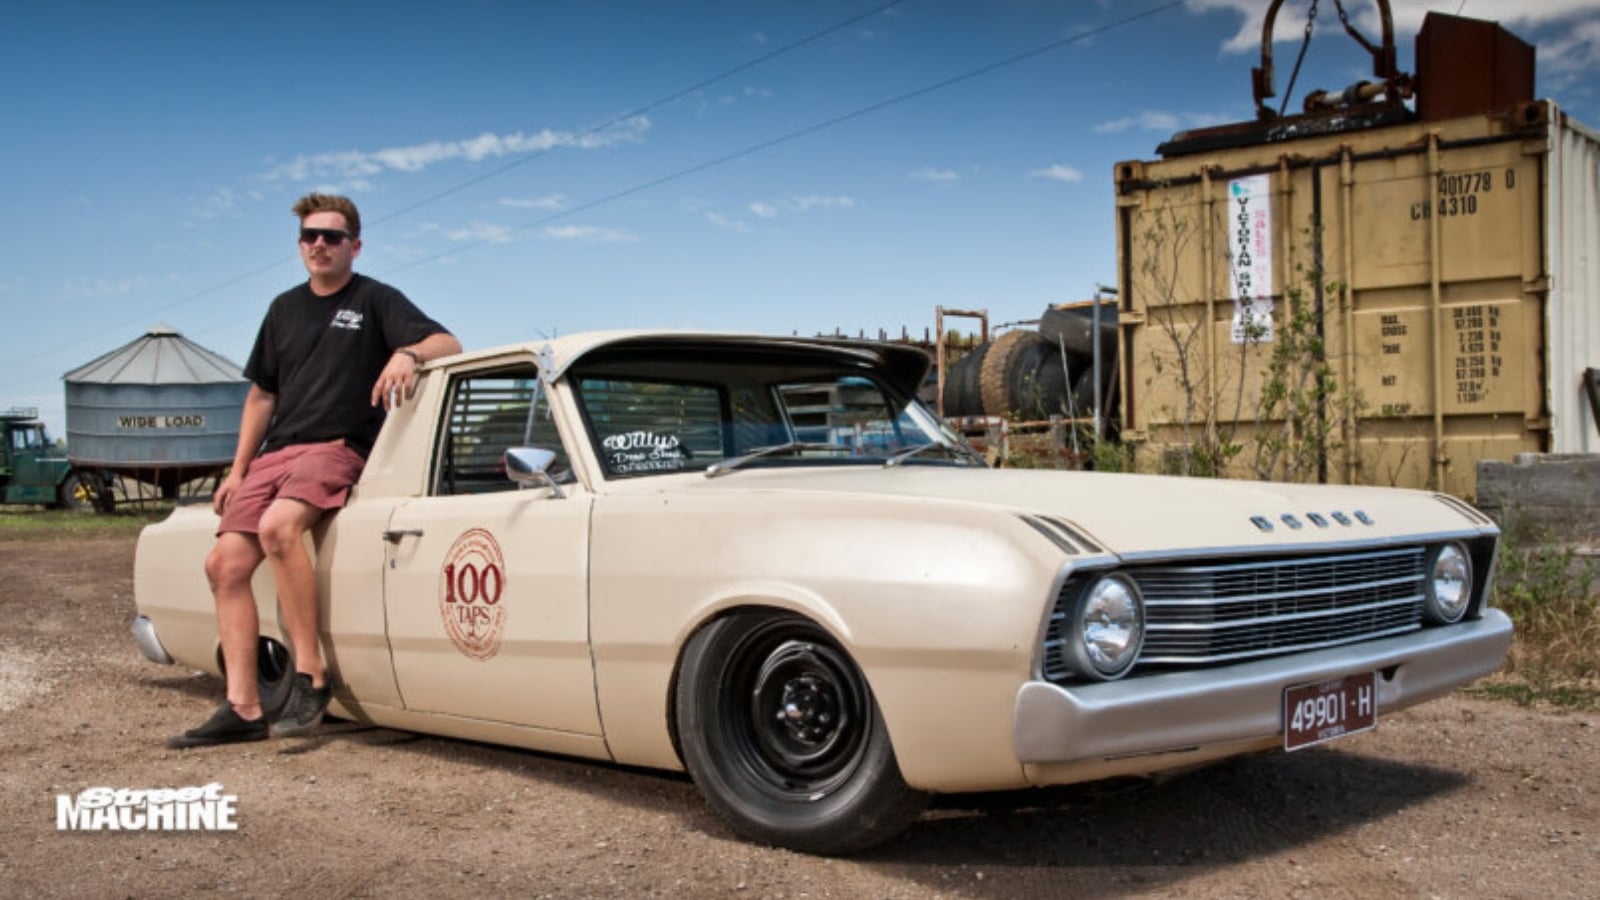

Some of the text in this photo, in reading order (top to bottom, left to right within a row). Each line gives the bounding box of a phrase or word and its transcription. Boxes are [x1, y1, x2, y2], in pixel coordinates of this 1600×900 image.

[1438, 194, 1477, 216] 4310
[1237, 197, 1251, 267] VICTORIAN
[119, 415, 202, 428] WIDE LOAD
[444, 562, 503, 605] 100
[457, 605, 491, 625] TAPS
